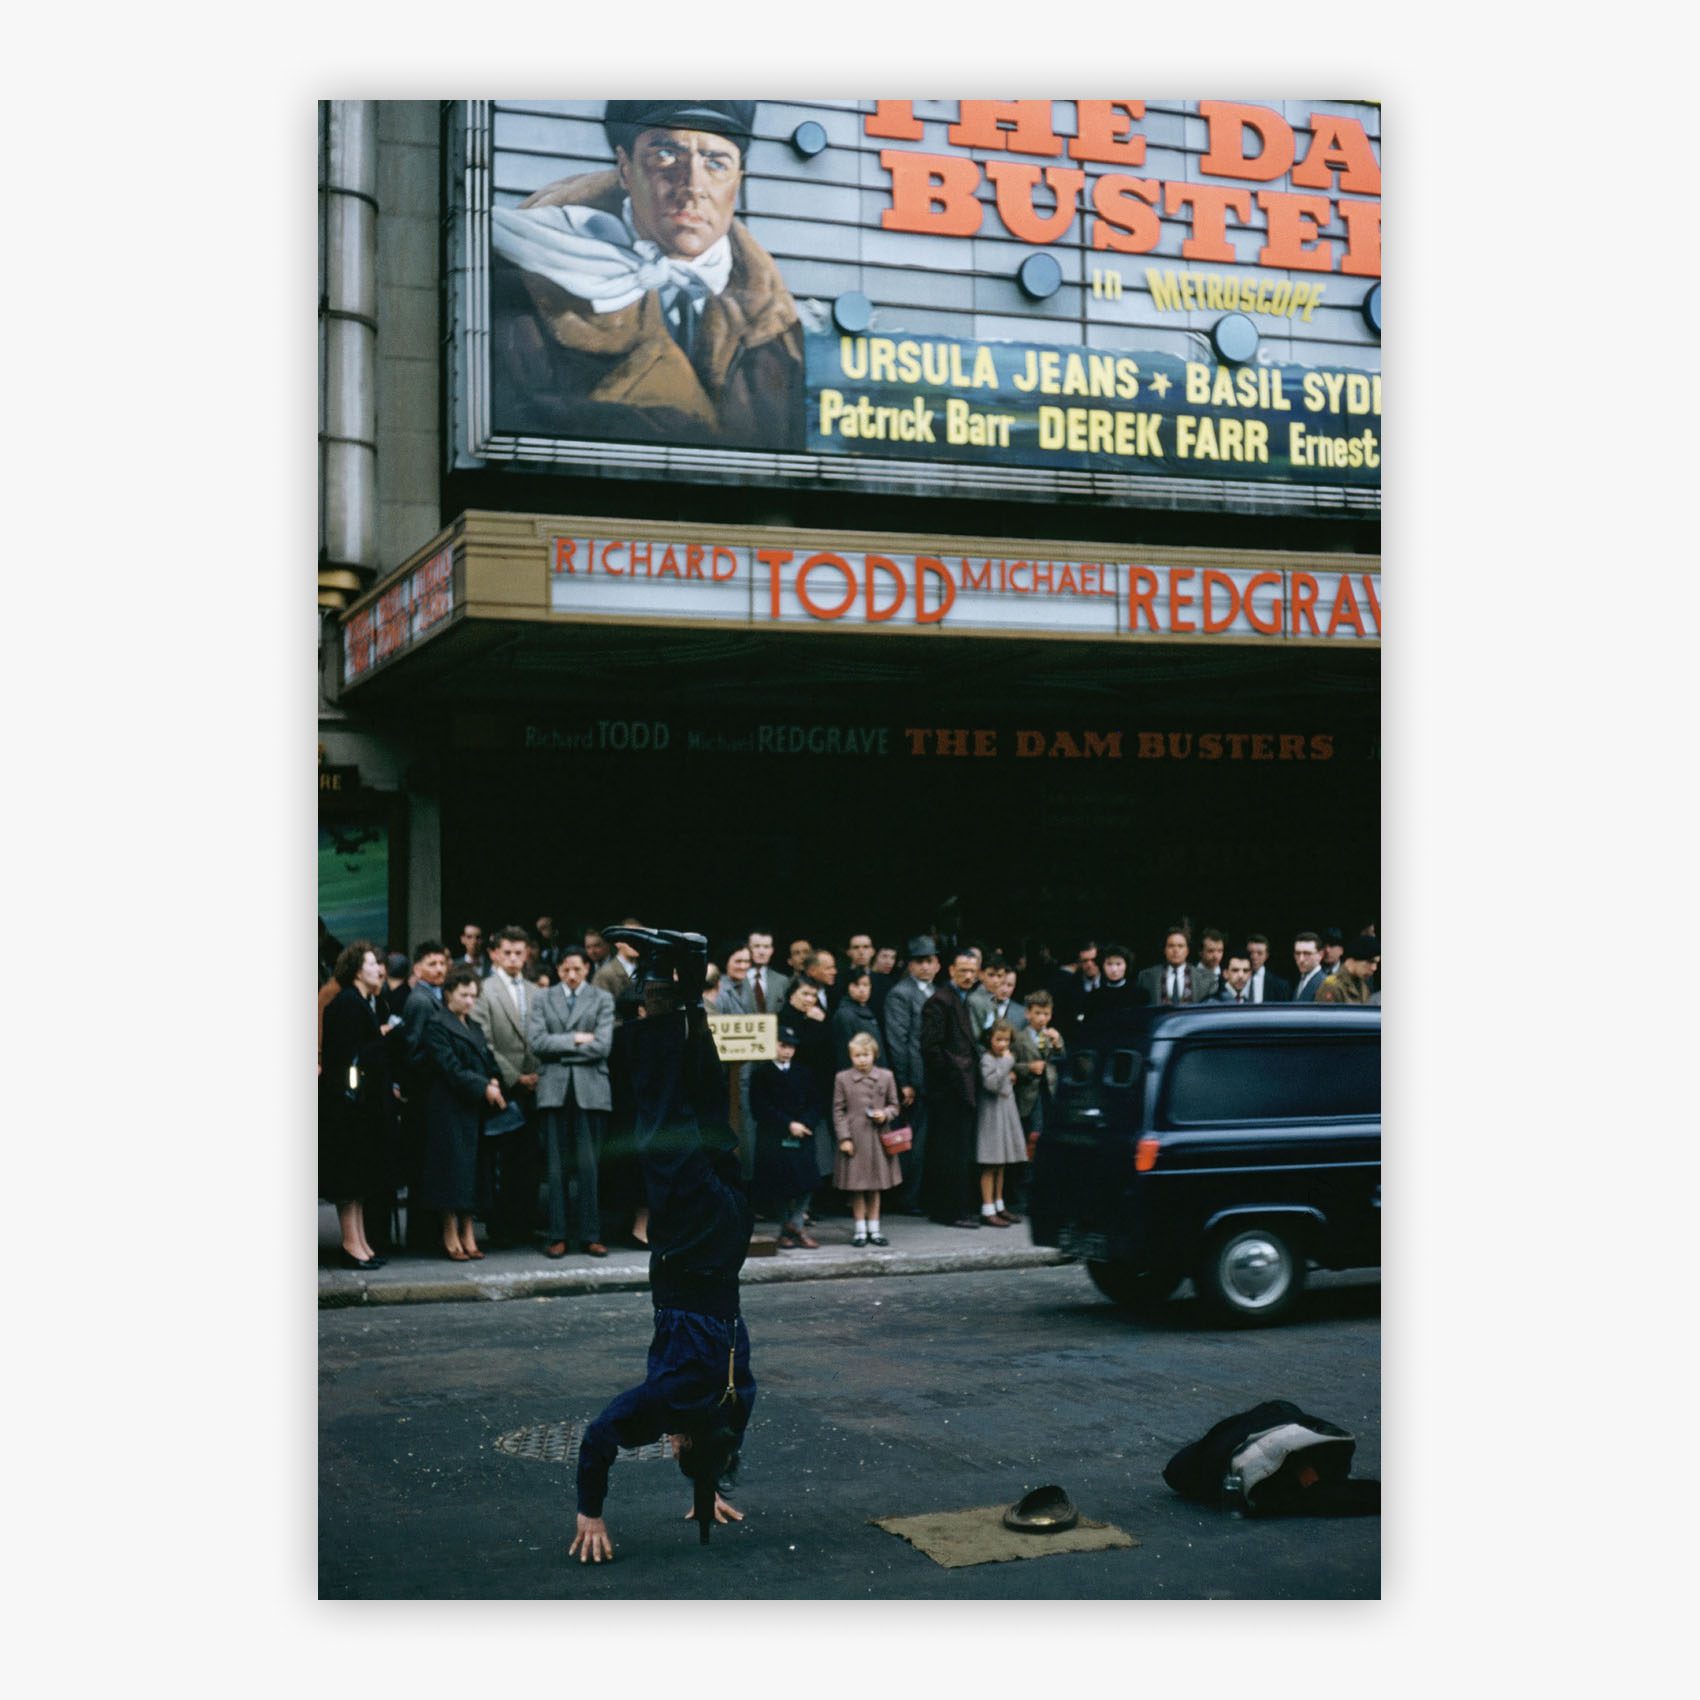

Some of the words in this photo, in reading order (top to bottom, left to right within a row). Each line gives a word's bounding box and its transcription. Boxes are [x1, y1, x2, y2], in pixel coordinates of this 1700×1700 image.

[840, 336, 999, 389] URSULA
[1012, 350, 1140, 400] JEANS
[1186, 361, 1292, 411] BASIL
[819, 388, 936, 443] Patrick
[946, 398, 1016, 448] Barr
[1038, 405, 1164, 458] DEREK
[1176, 414, 1270, 464] FARR
[1289, 421, 1380, 468] Ernest
[555, 537, 738, 581] RICHARD
[757, 550, 956, 622] TODD
[961, 558, 1116, 596] MICHAEL
[598, 720, 670, 751] TODD
[758, 725, 889, 755] REDGRAVE
[905, 728, 998, 757] THE
[1015, 729, 1123, 758] DAM
[1138, 732, 1335, 760] BUSTERS
